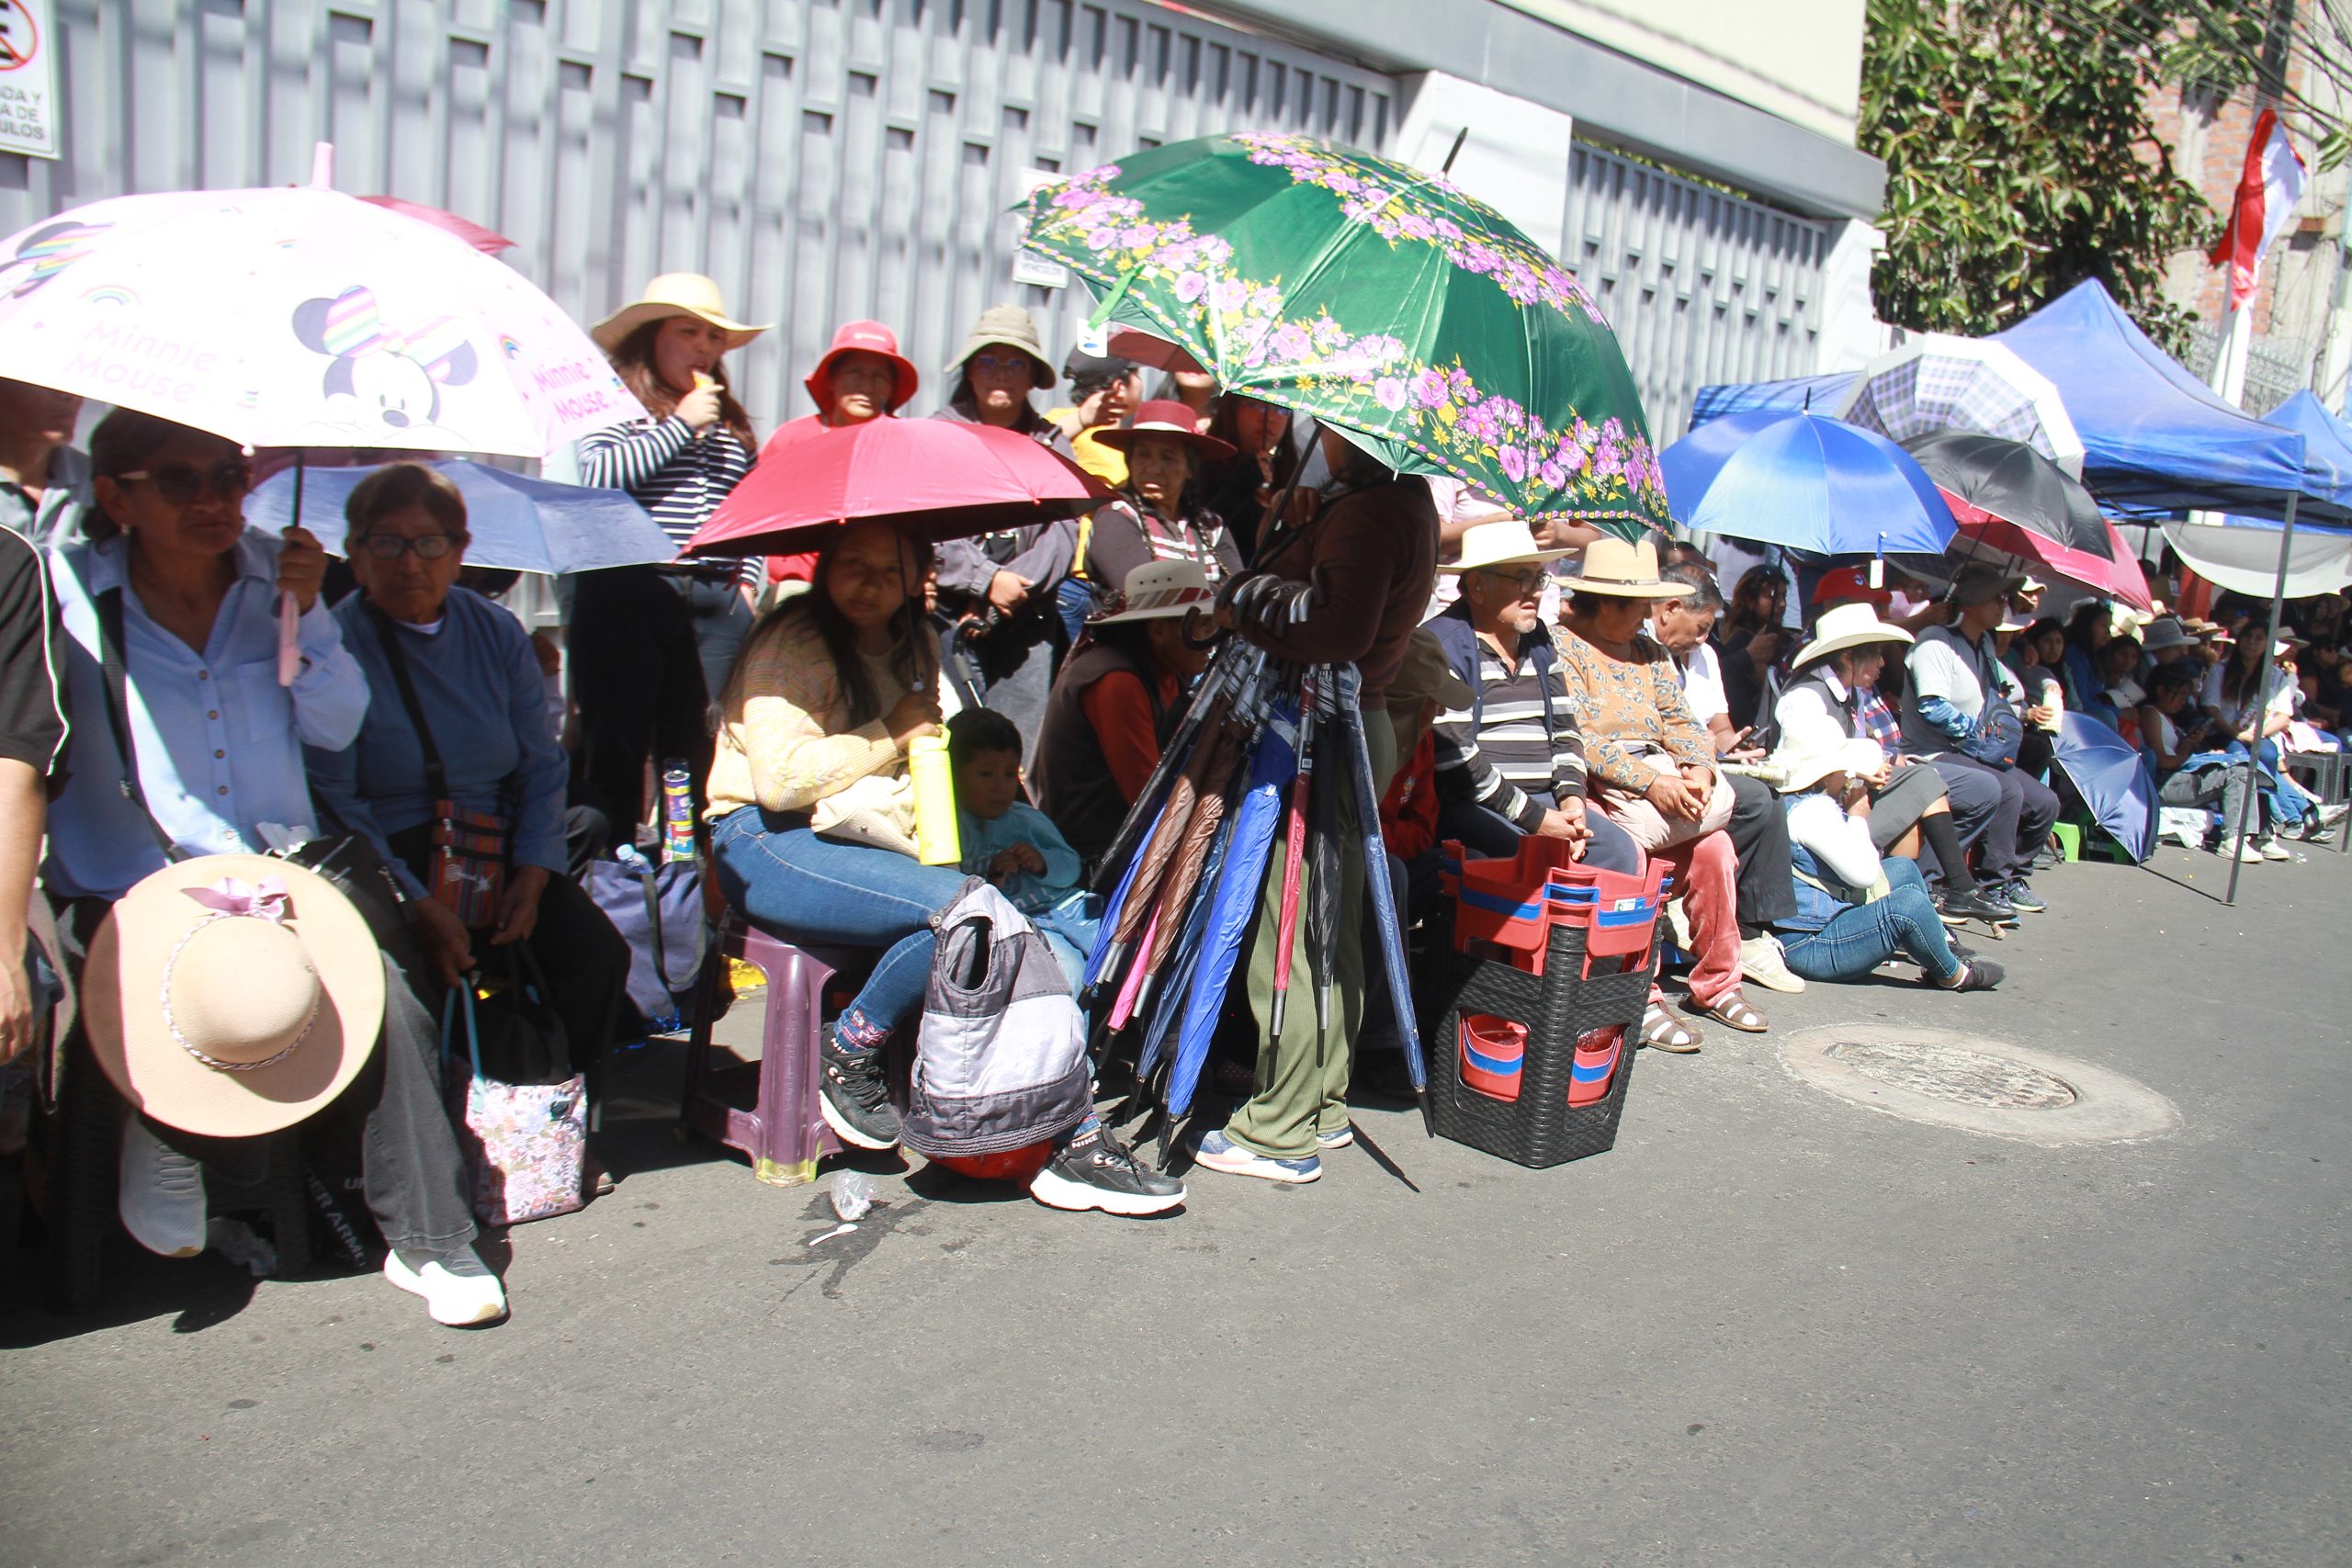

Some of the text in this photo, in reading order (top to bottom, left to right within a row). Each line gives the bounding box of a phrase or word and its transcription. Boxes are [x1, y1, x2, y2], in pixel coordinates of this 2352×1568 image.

[0, 85, 42, 104] DA Y
[0, 102, 39, 123] A DE
[0, 119, 44, 140] ULOS
[82, 321, 218, 373] Minnie
[62, 350, 197, 403] Mouse
[531, 361, 591, 393] Minnie
[552, 389, 609, 423] Mouse
[1071, 1134, 1099, 1149] NIKE
